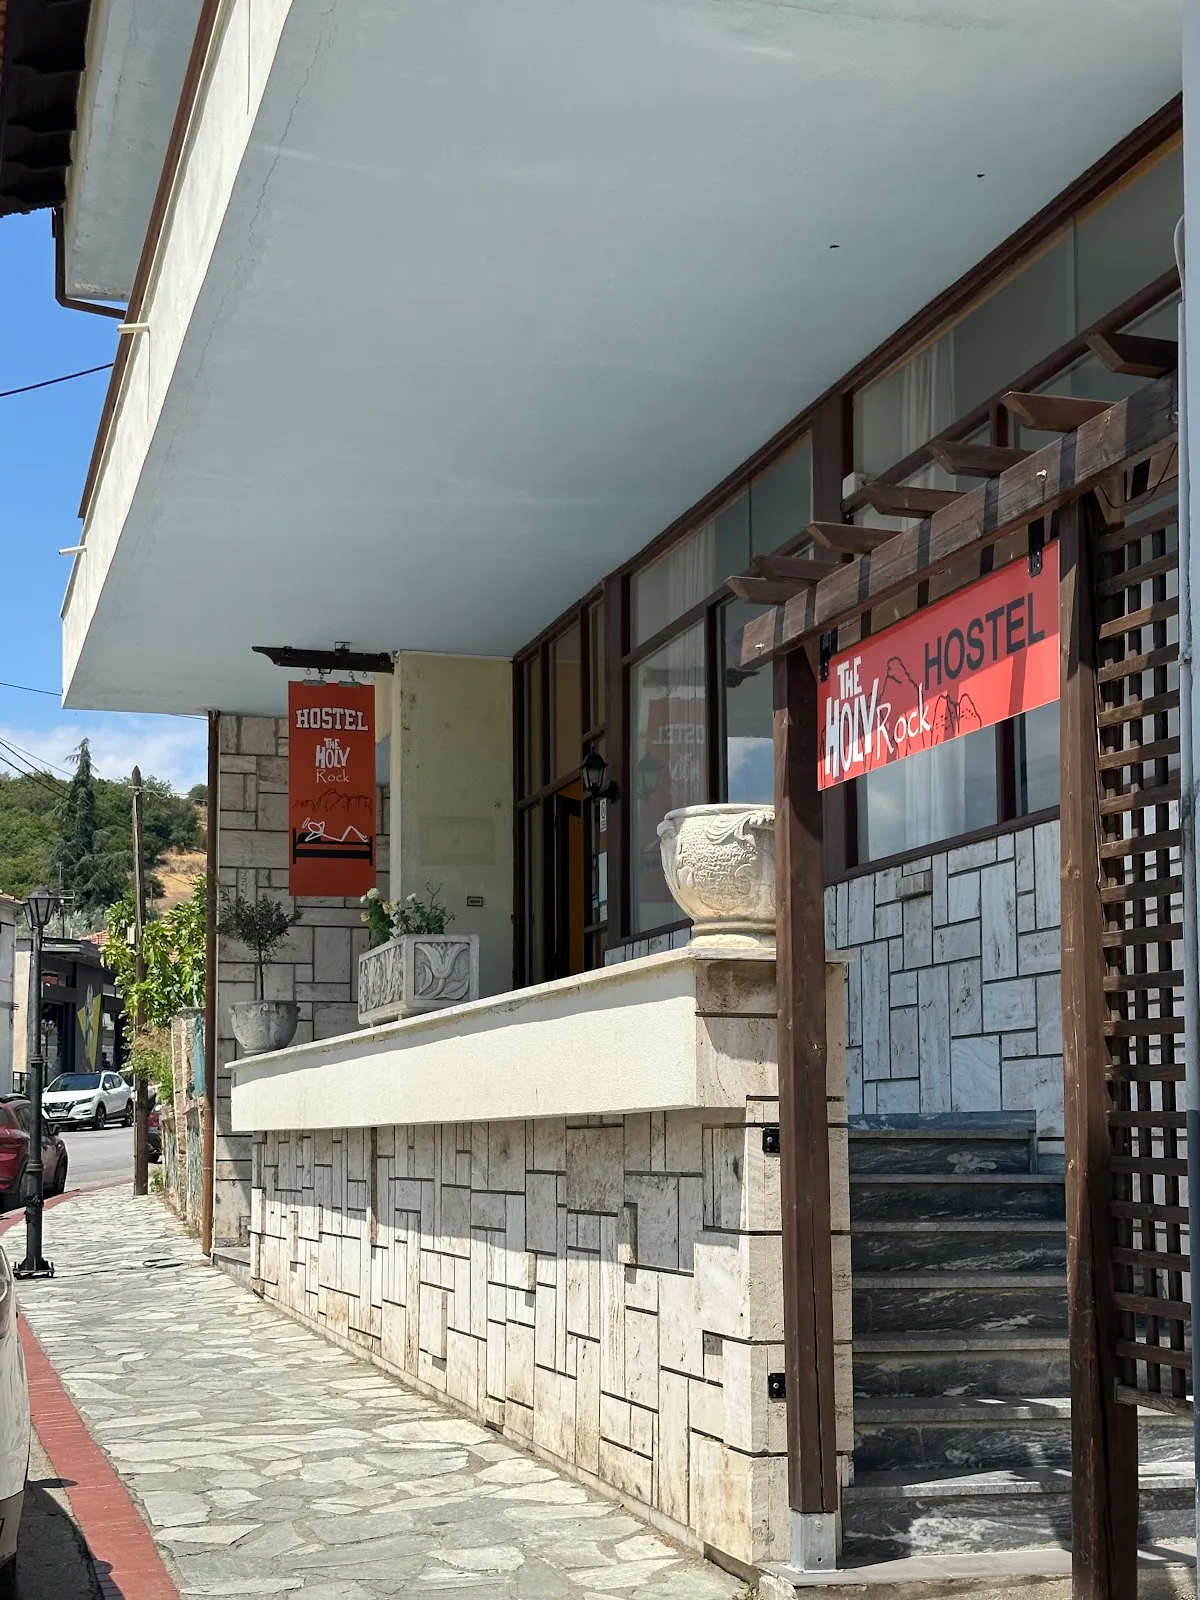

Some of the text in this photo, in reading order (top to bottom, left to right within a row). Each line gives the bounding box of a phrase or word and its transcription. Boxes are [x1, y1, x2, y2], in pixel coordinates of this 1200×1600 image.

[924, 592, 1045, 690] HOSTEL
[836, 656, 863, 700] THE
[296, 707, 368, 730] HOSTEL
[824, 677, 931, 779] HOLY Rock
[324, 737, 340, 750] THE
[315, 745, 351, 769] HOLY
[316, 768, 350, 783] Rock
